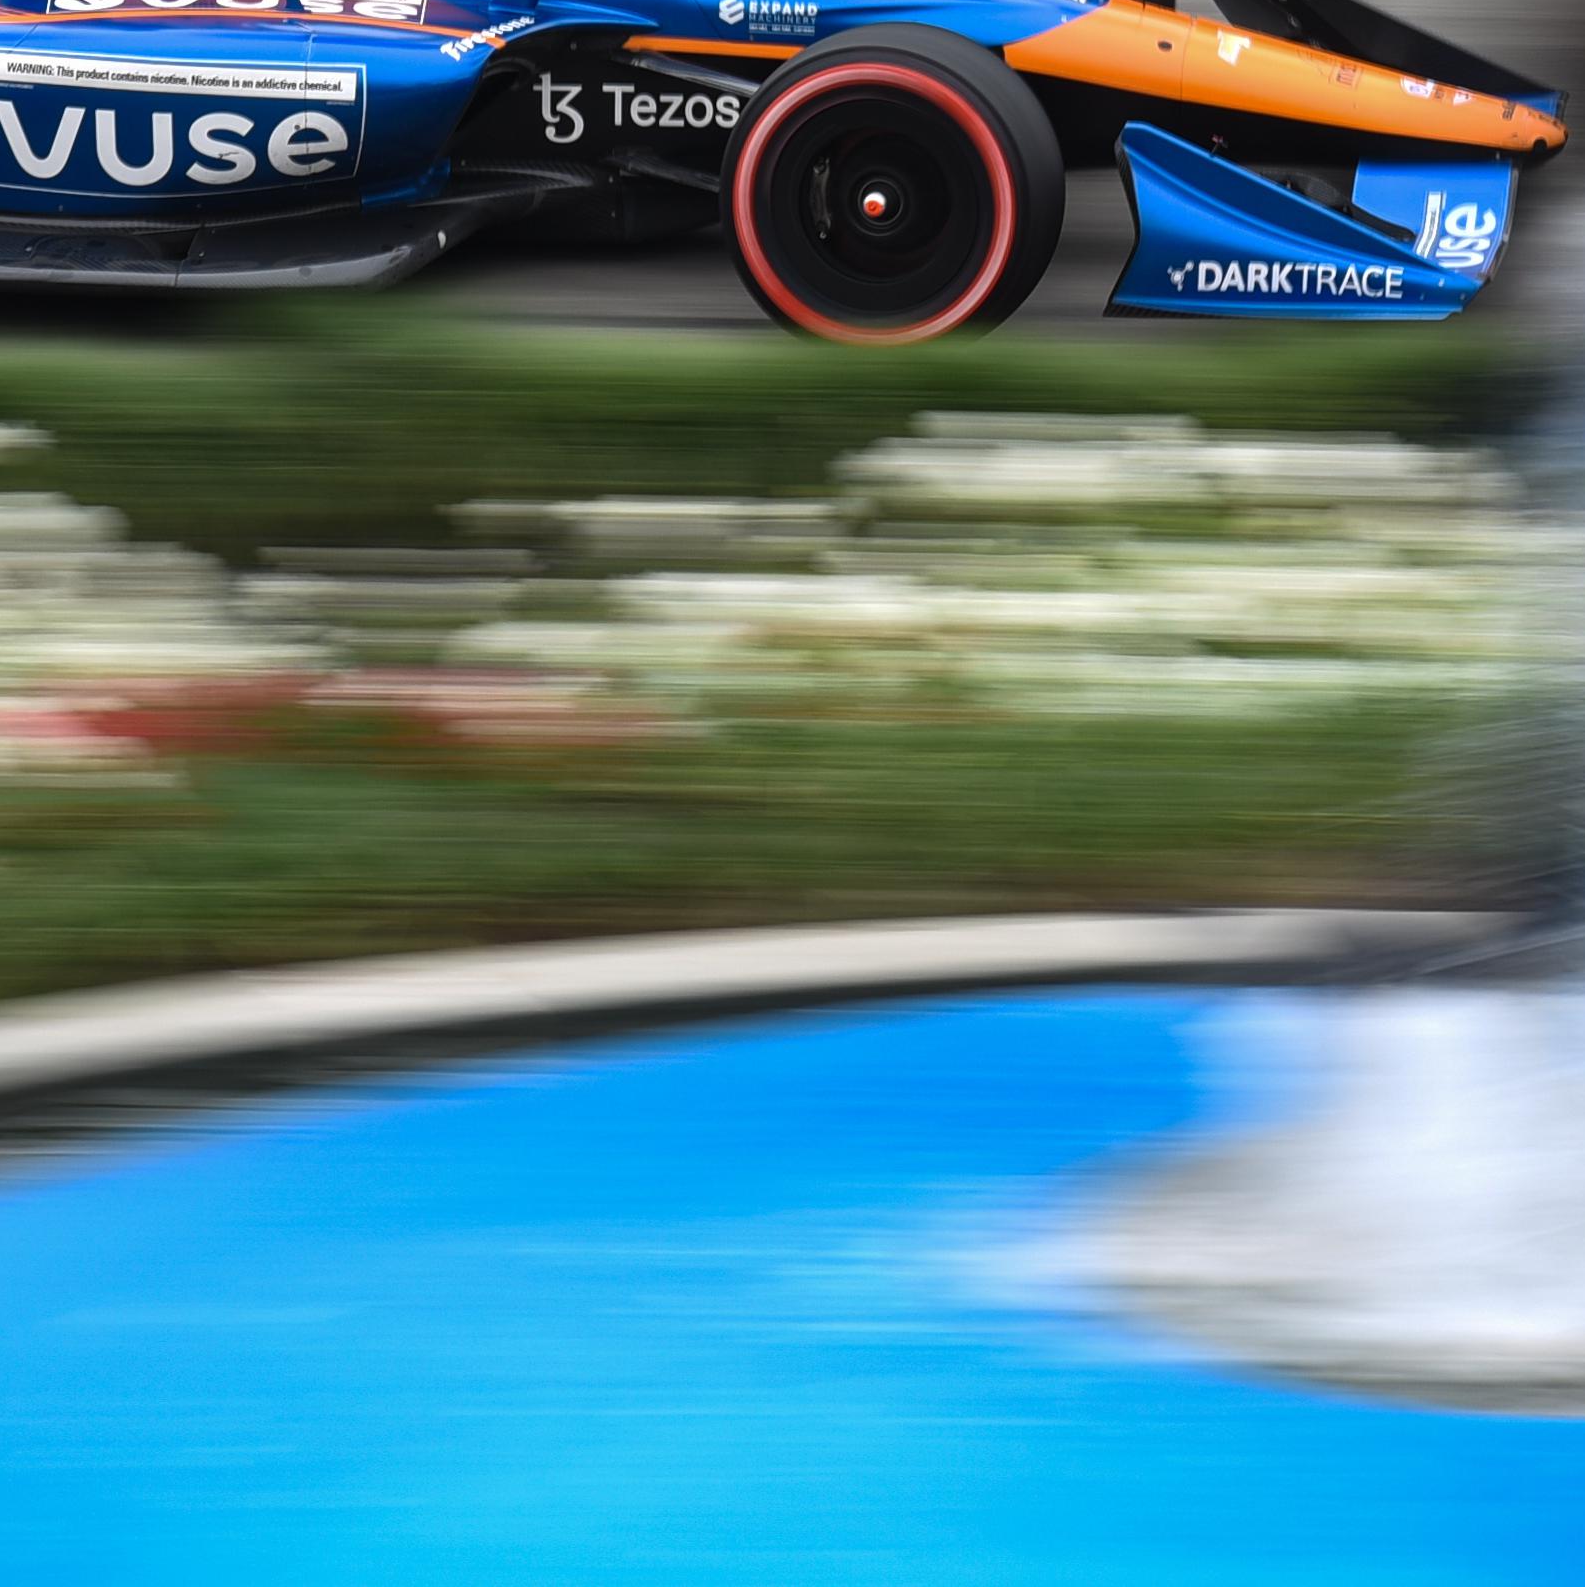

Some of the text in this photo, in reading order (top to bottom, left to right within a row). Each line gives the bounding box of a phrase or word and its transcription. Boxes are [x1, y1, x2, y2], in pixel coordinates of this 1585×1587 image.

[440, 16, 535, 61] Firestone
[749, 14, 816, 25] MACHINERY
[7, 62, 343, 92] WARNING: This product contains nicotine. Nicotine is an addictive chemical.
[602, 83, 740, 128] Tezos
[1197, 260, 1405, 299] DARKTRACE
